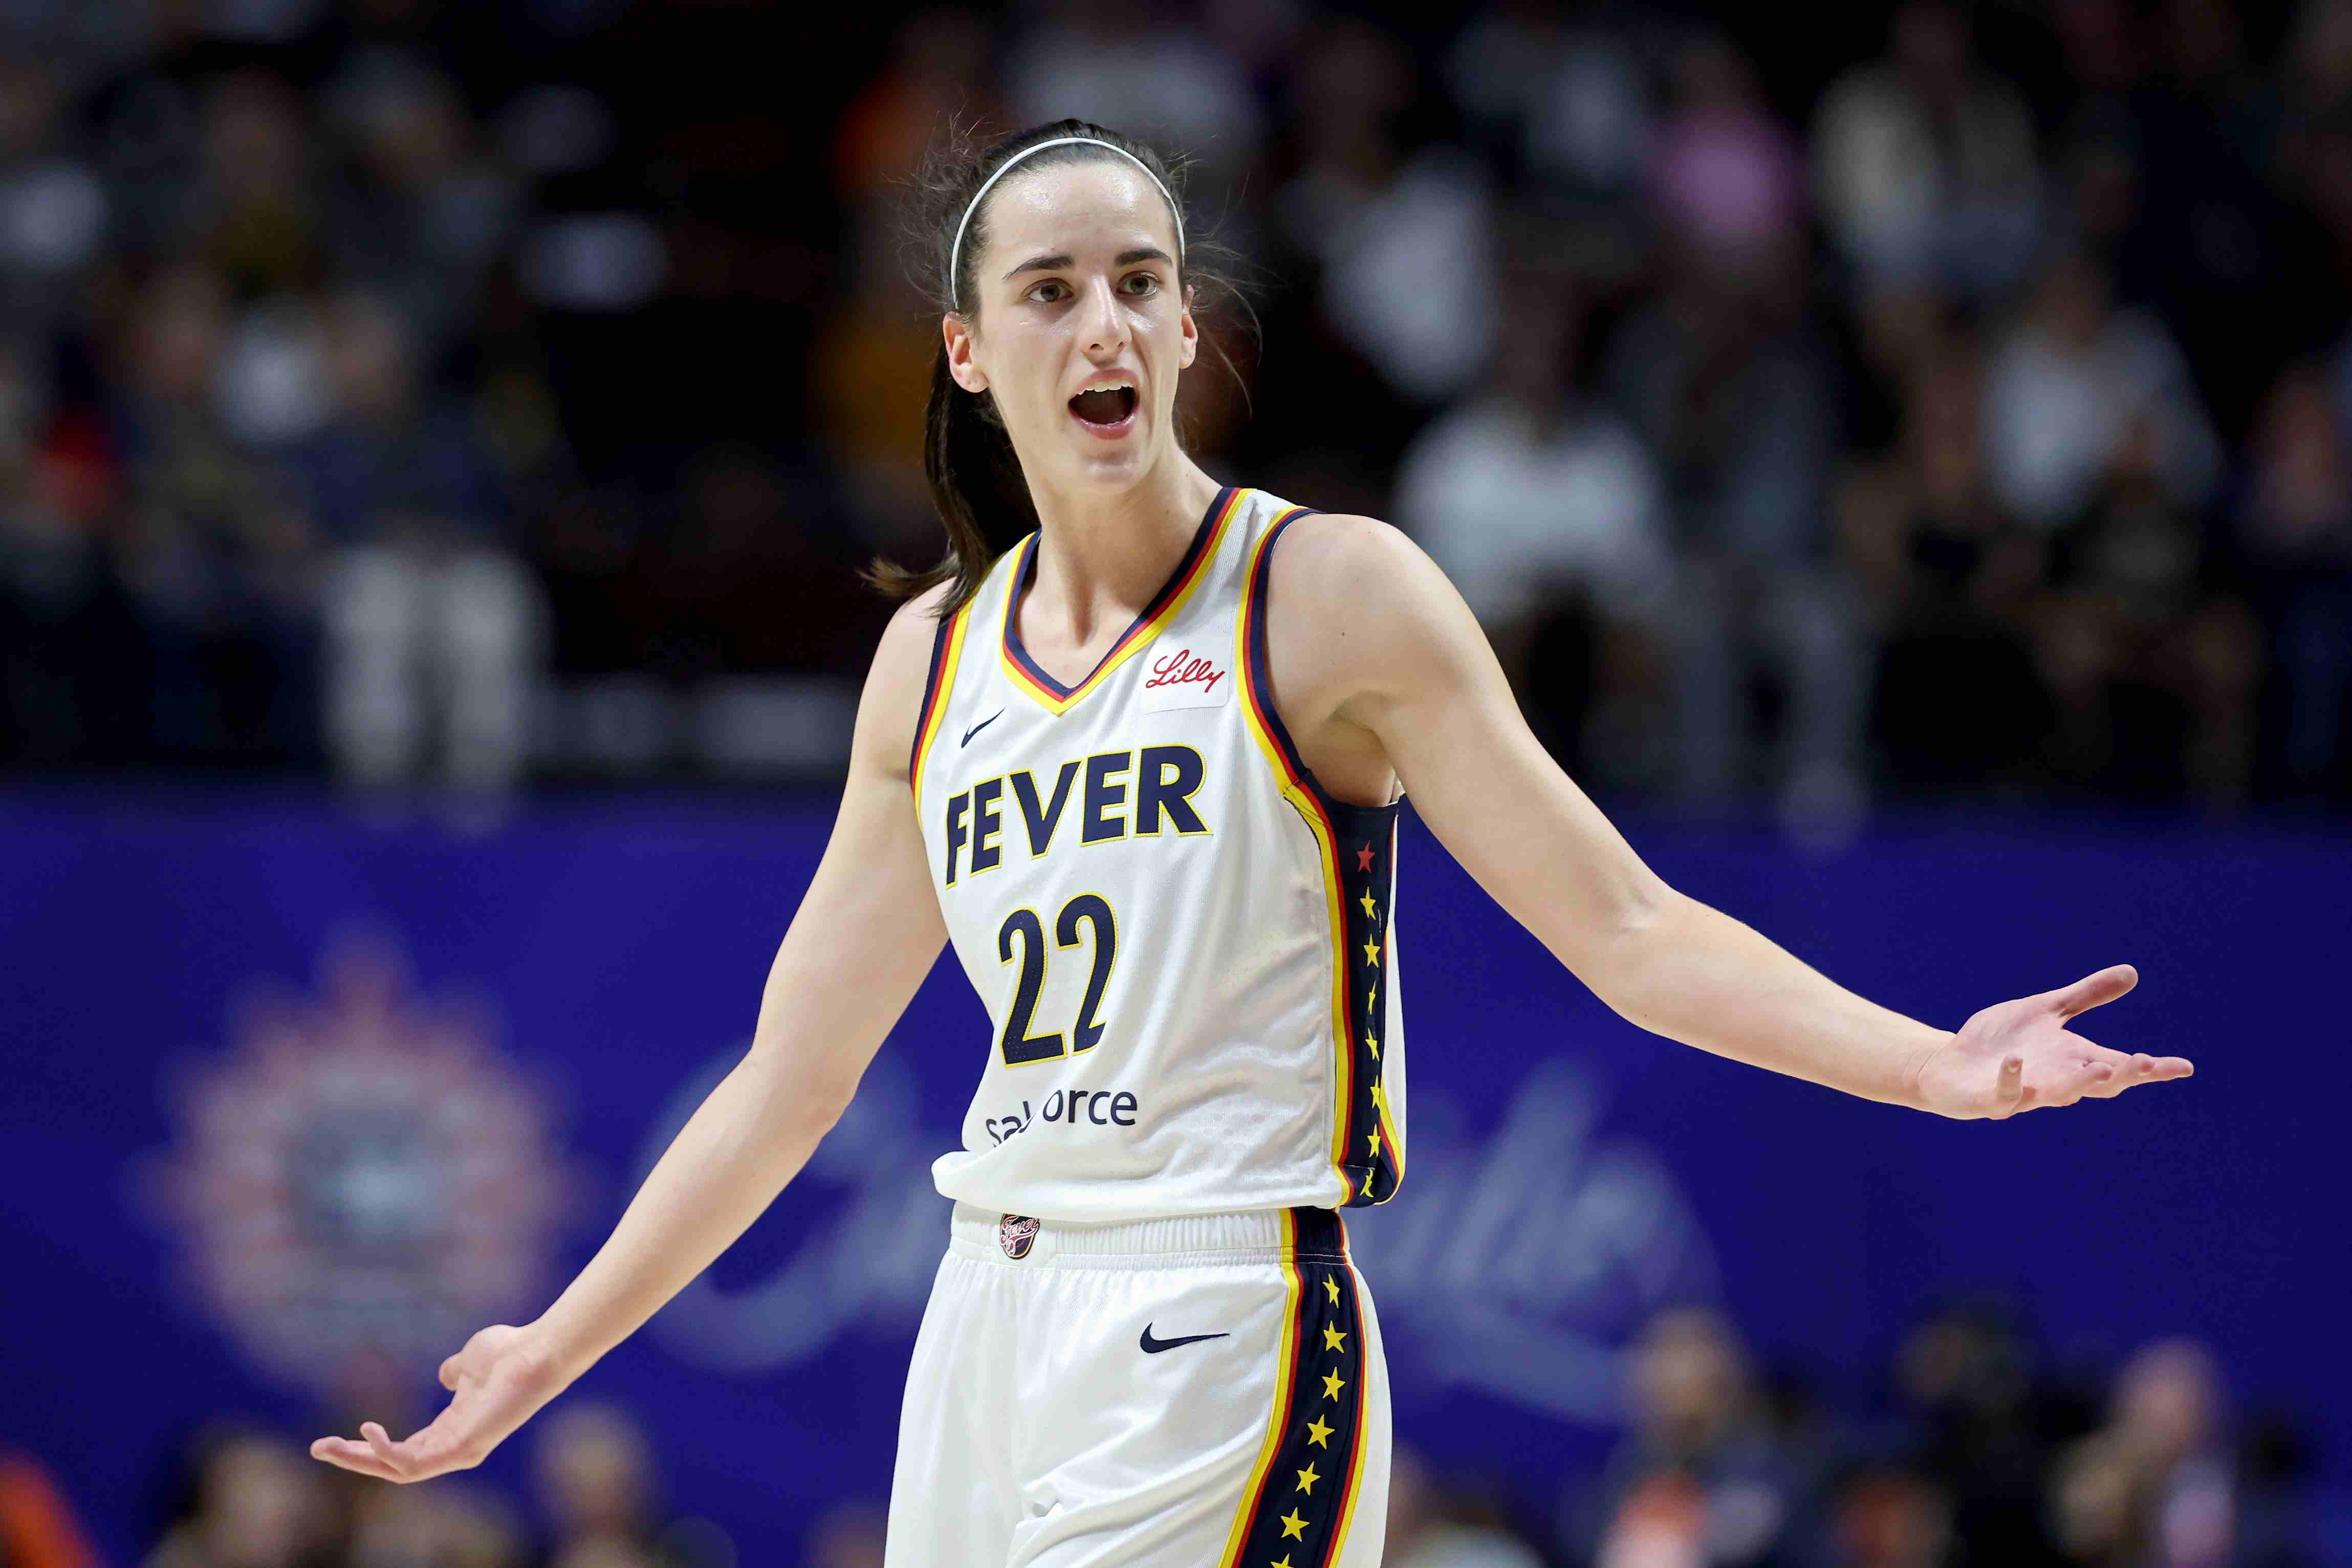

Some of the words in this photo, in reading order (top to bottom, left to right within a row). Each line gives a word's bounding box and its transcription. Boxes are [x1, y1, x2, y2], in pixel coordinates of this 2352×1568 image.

[1145, 648, 1226, 693] Lilly
[946, 743, 1213, 889] FEVER
[998, 890, 1119, 1069] 22
